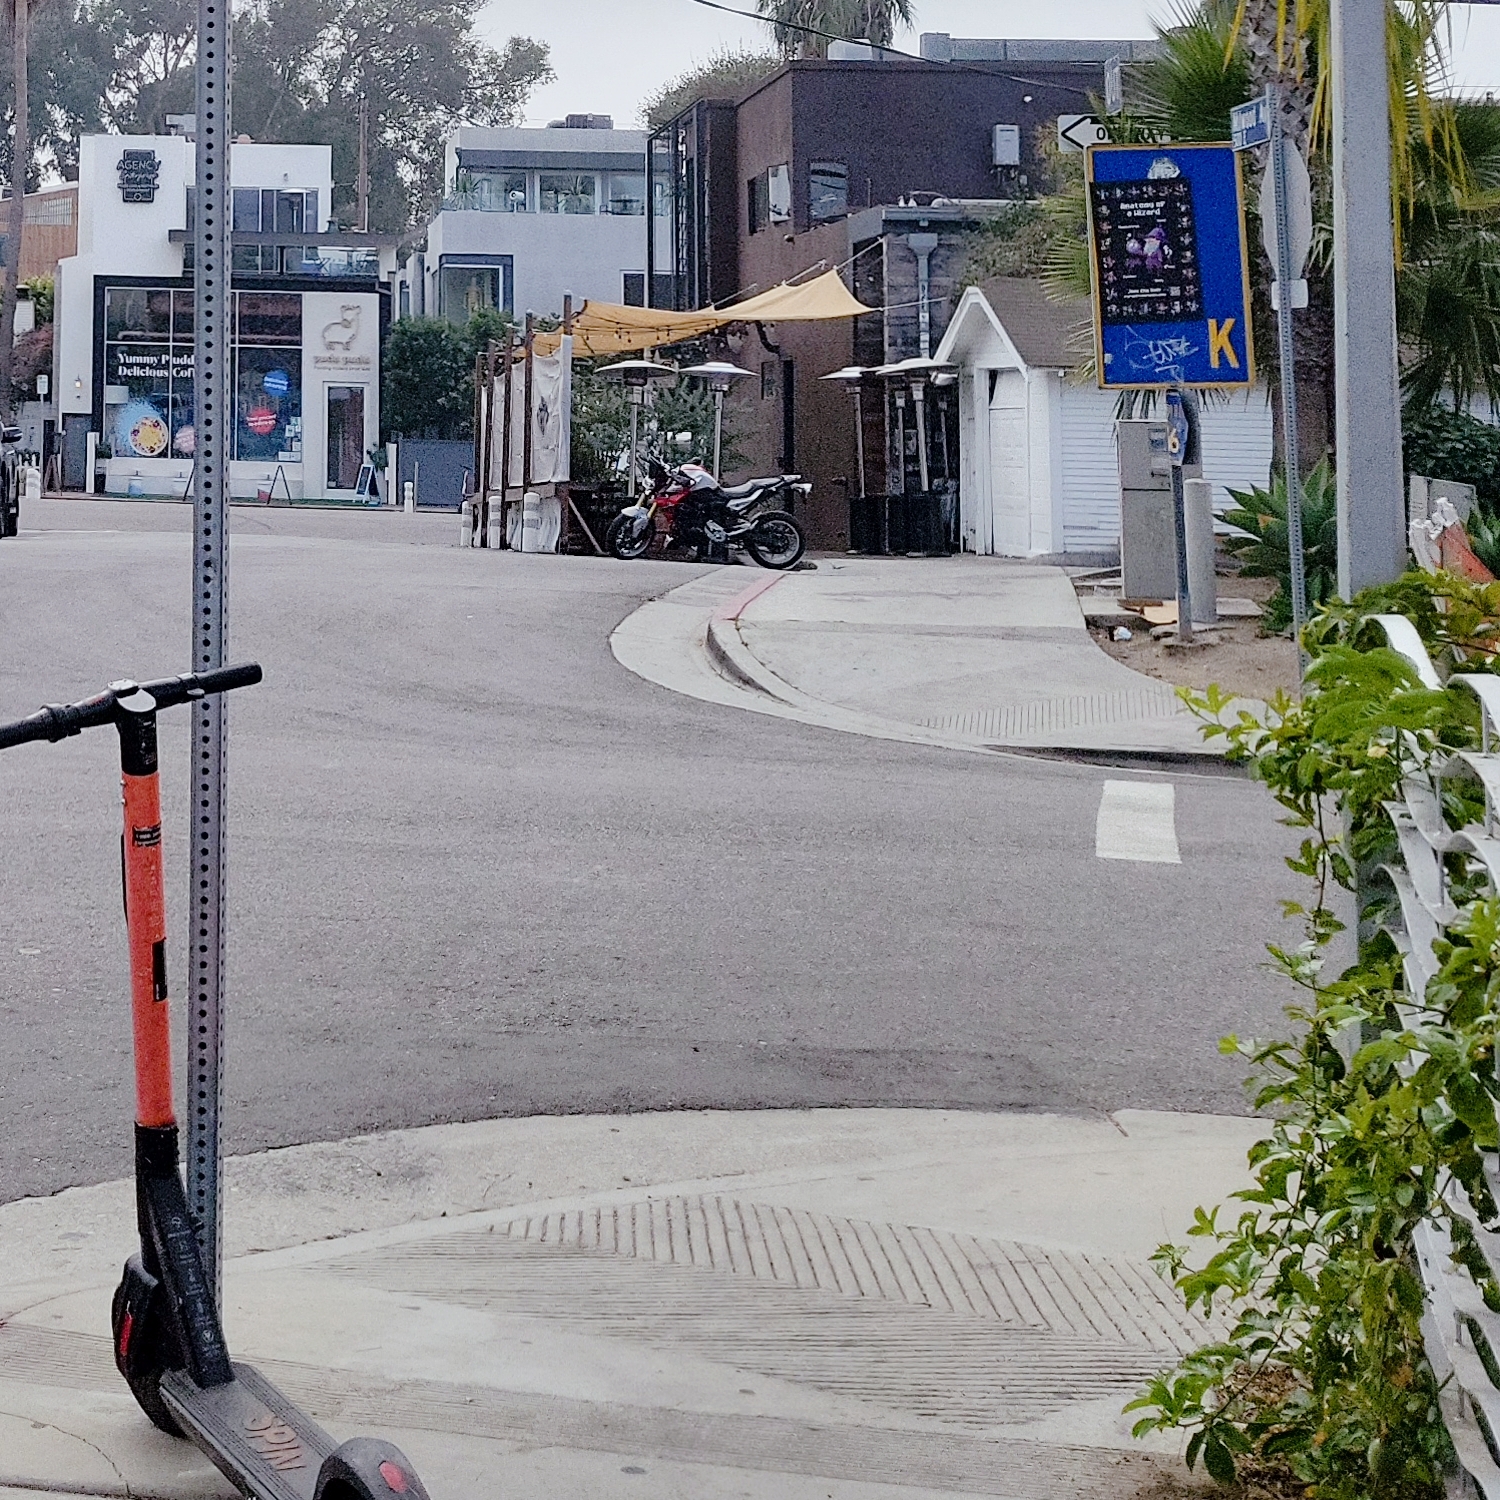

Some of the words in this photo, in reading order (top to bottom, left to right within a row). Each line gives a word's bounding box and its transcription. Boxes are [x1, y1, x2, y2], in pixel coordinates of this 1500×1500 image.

[116, 159, 161, 171] AGENCY
[118, 353, 160, 367] Yummy
[161, 354, 195, 365] Pudd
[118, 365, 169, 377] Delicious
